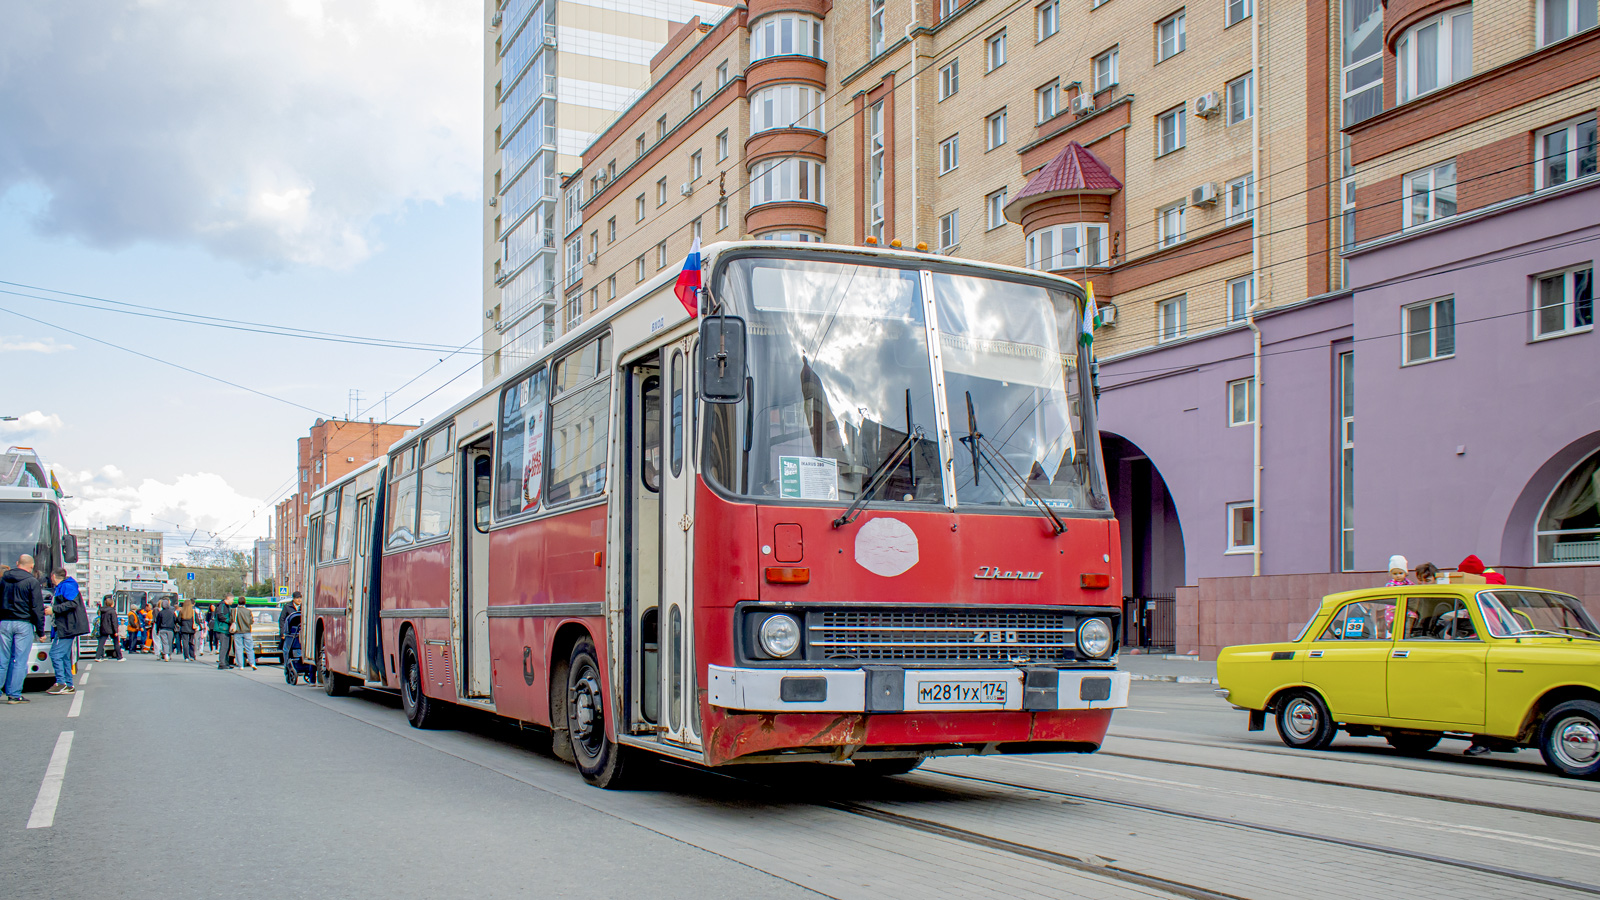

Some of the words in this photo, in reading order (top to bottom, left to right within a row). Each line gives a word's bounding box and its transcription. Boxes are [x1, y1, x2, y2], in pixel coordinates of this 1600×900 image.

[974, 566, 1043, 580] Ikarus
[973, 631, 1017, 643] 280
[982, 683, 1005, 696] 174
